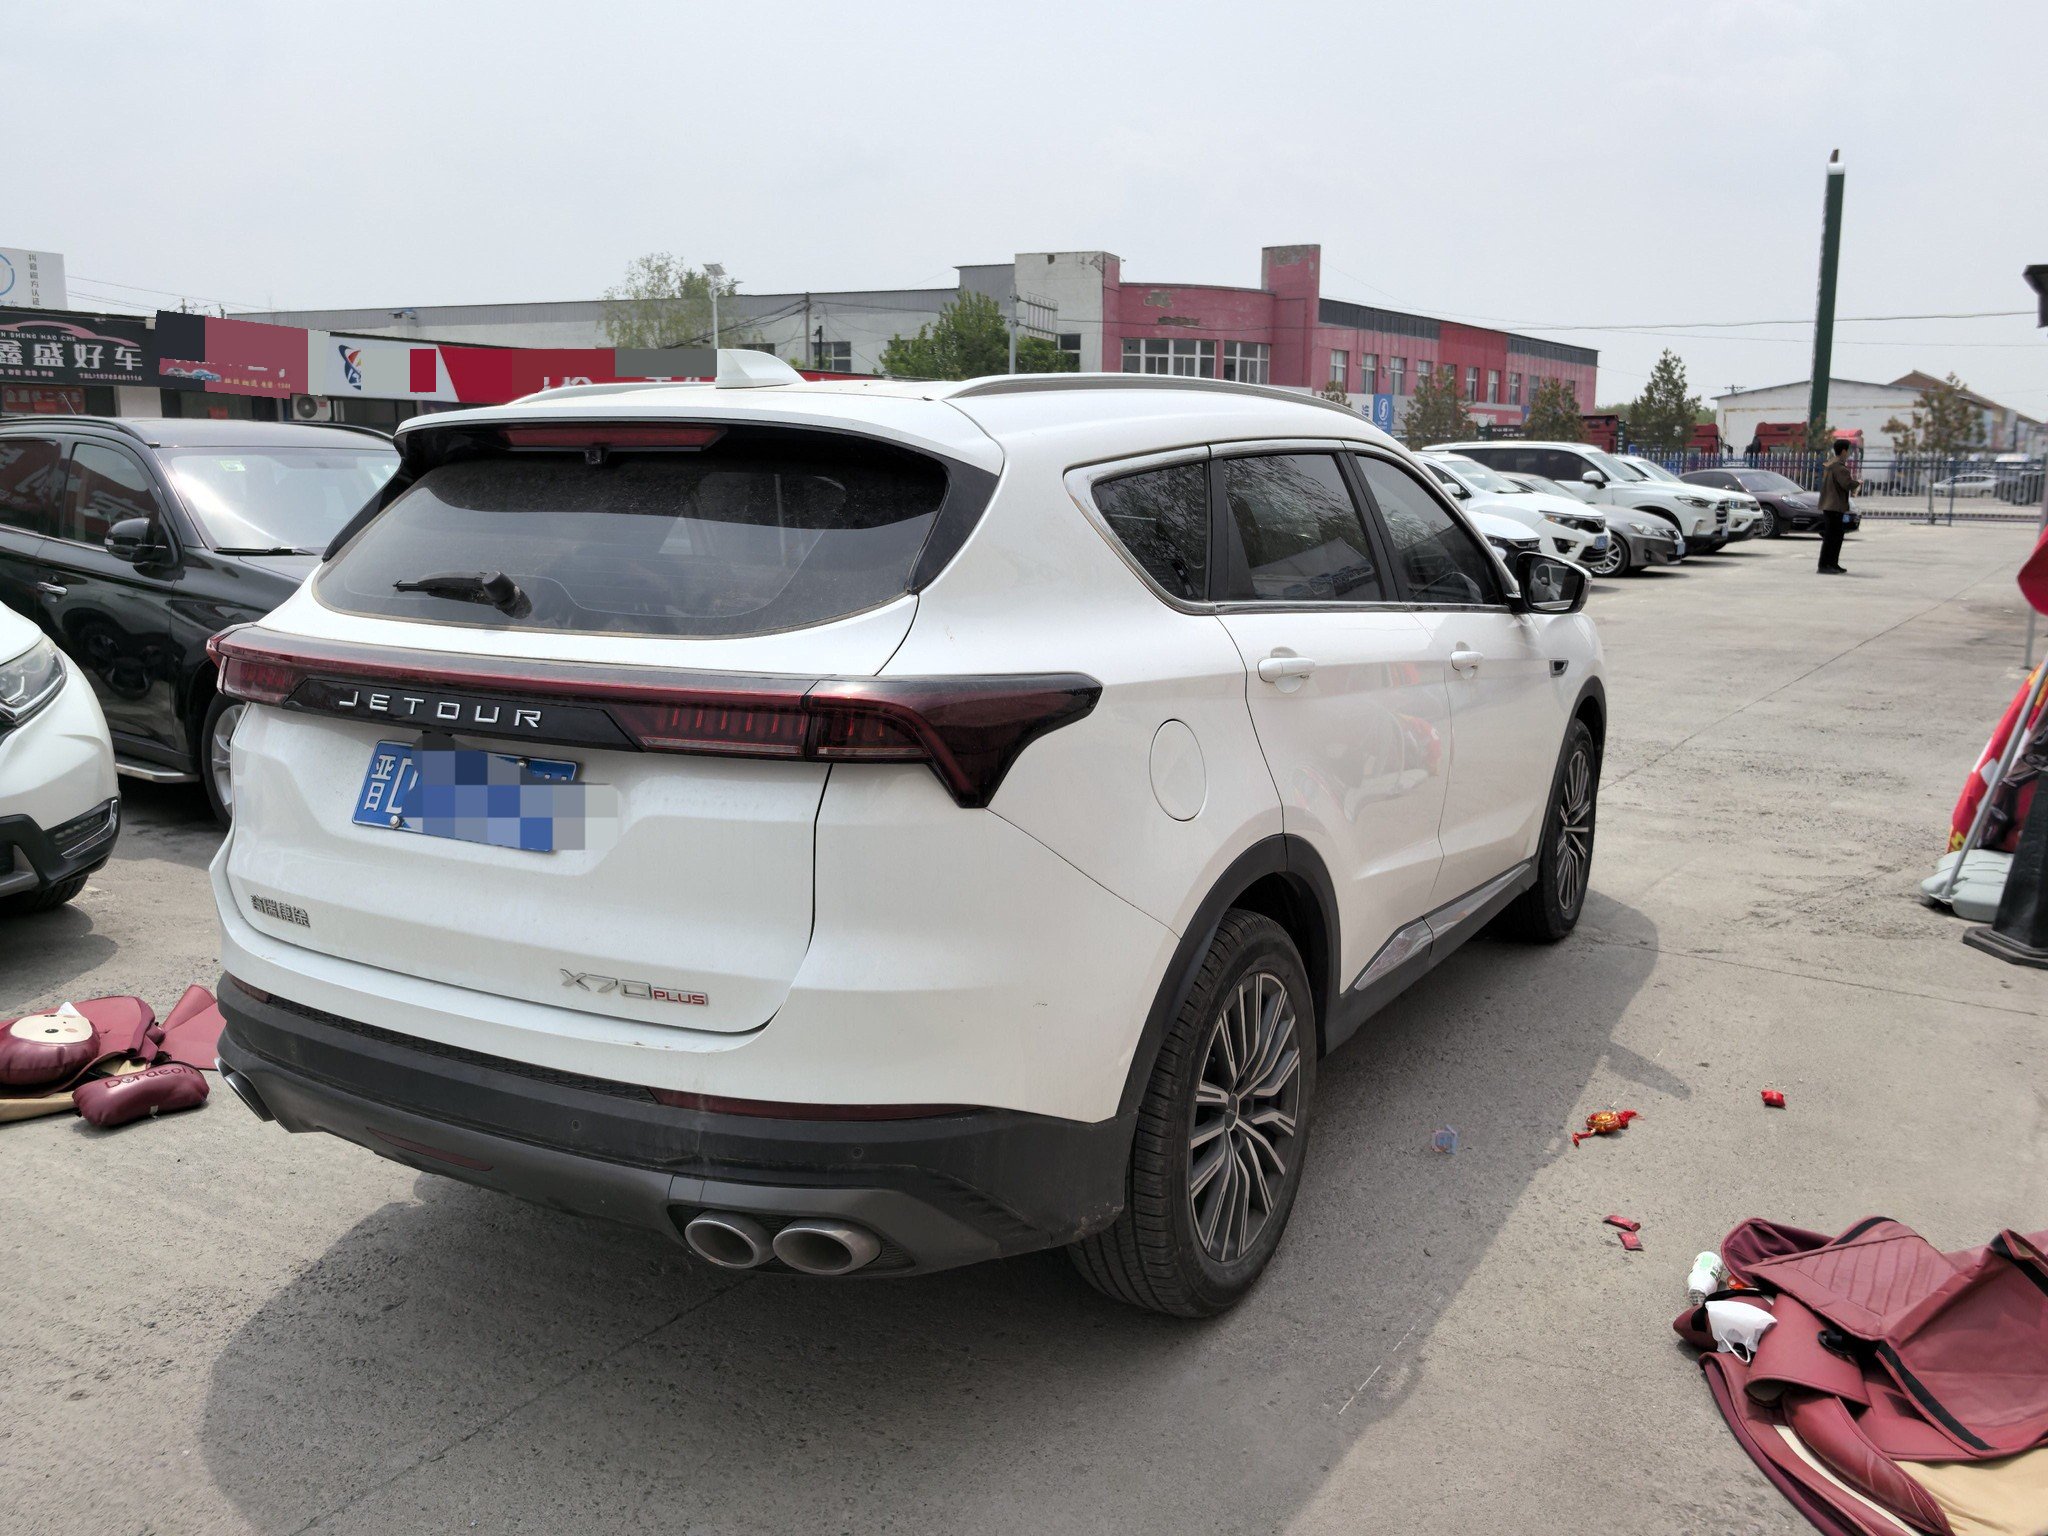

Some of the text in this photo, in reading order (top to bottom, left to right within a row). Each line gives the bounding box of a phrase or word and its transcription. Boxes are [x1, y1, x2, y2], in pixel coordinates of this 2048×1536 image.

[0, 340, 143, 371] 鑫盛好车
[339, 691, 542, 728] JETOUR
[560, 968, 709, 1006] X70 PLUS
